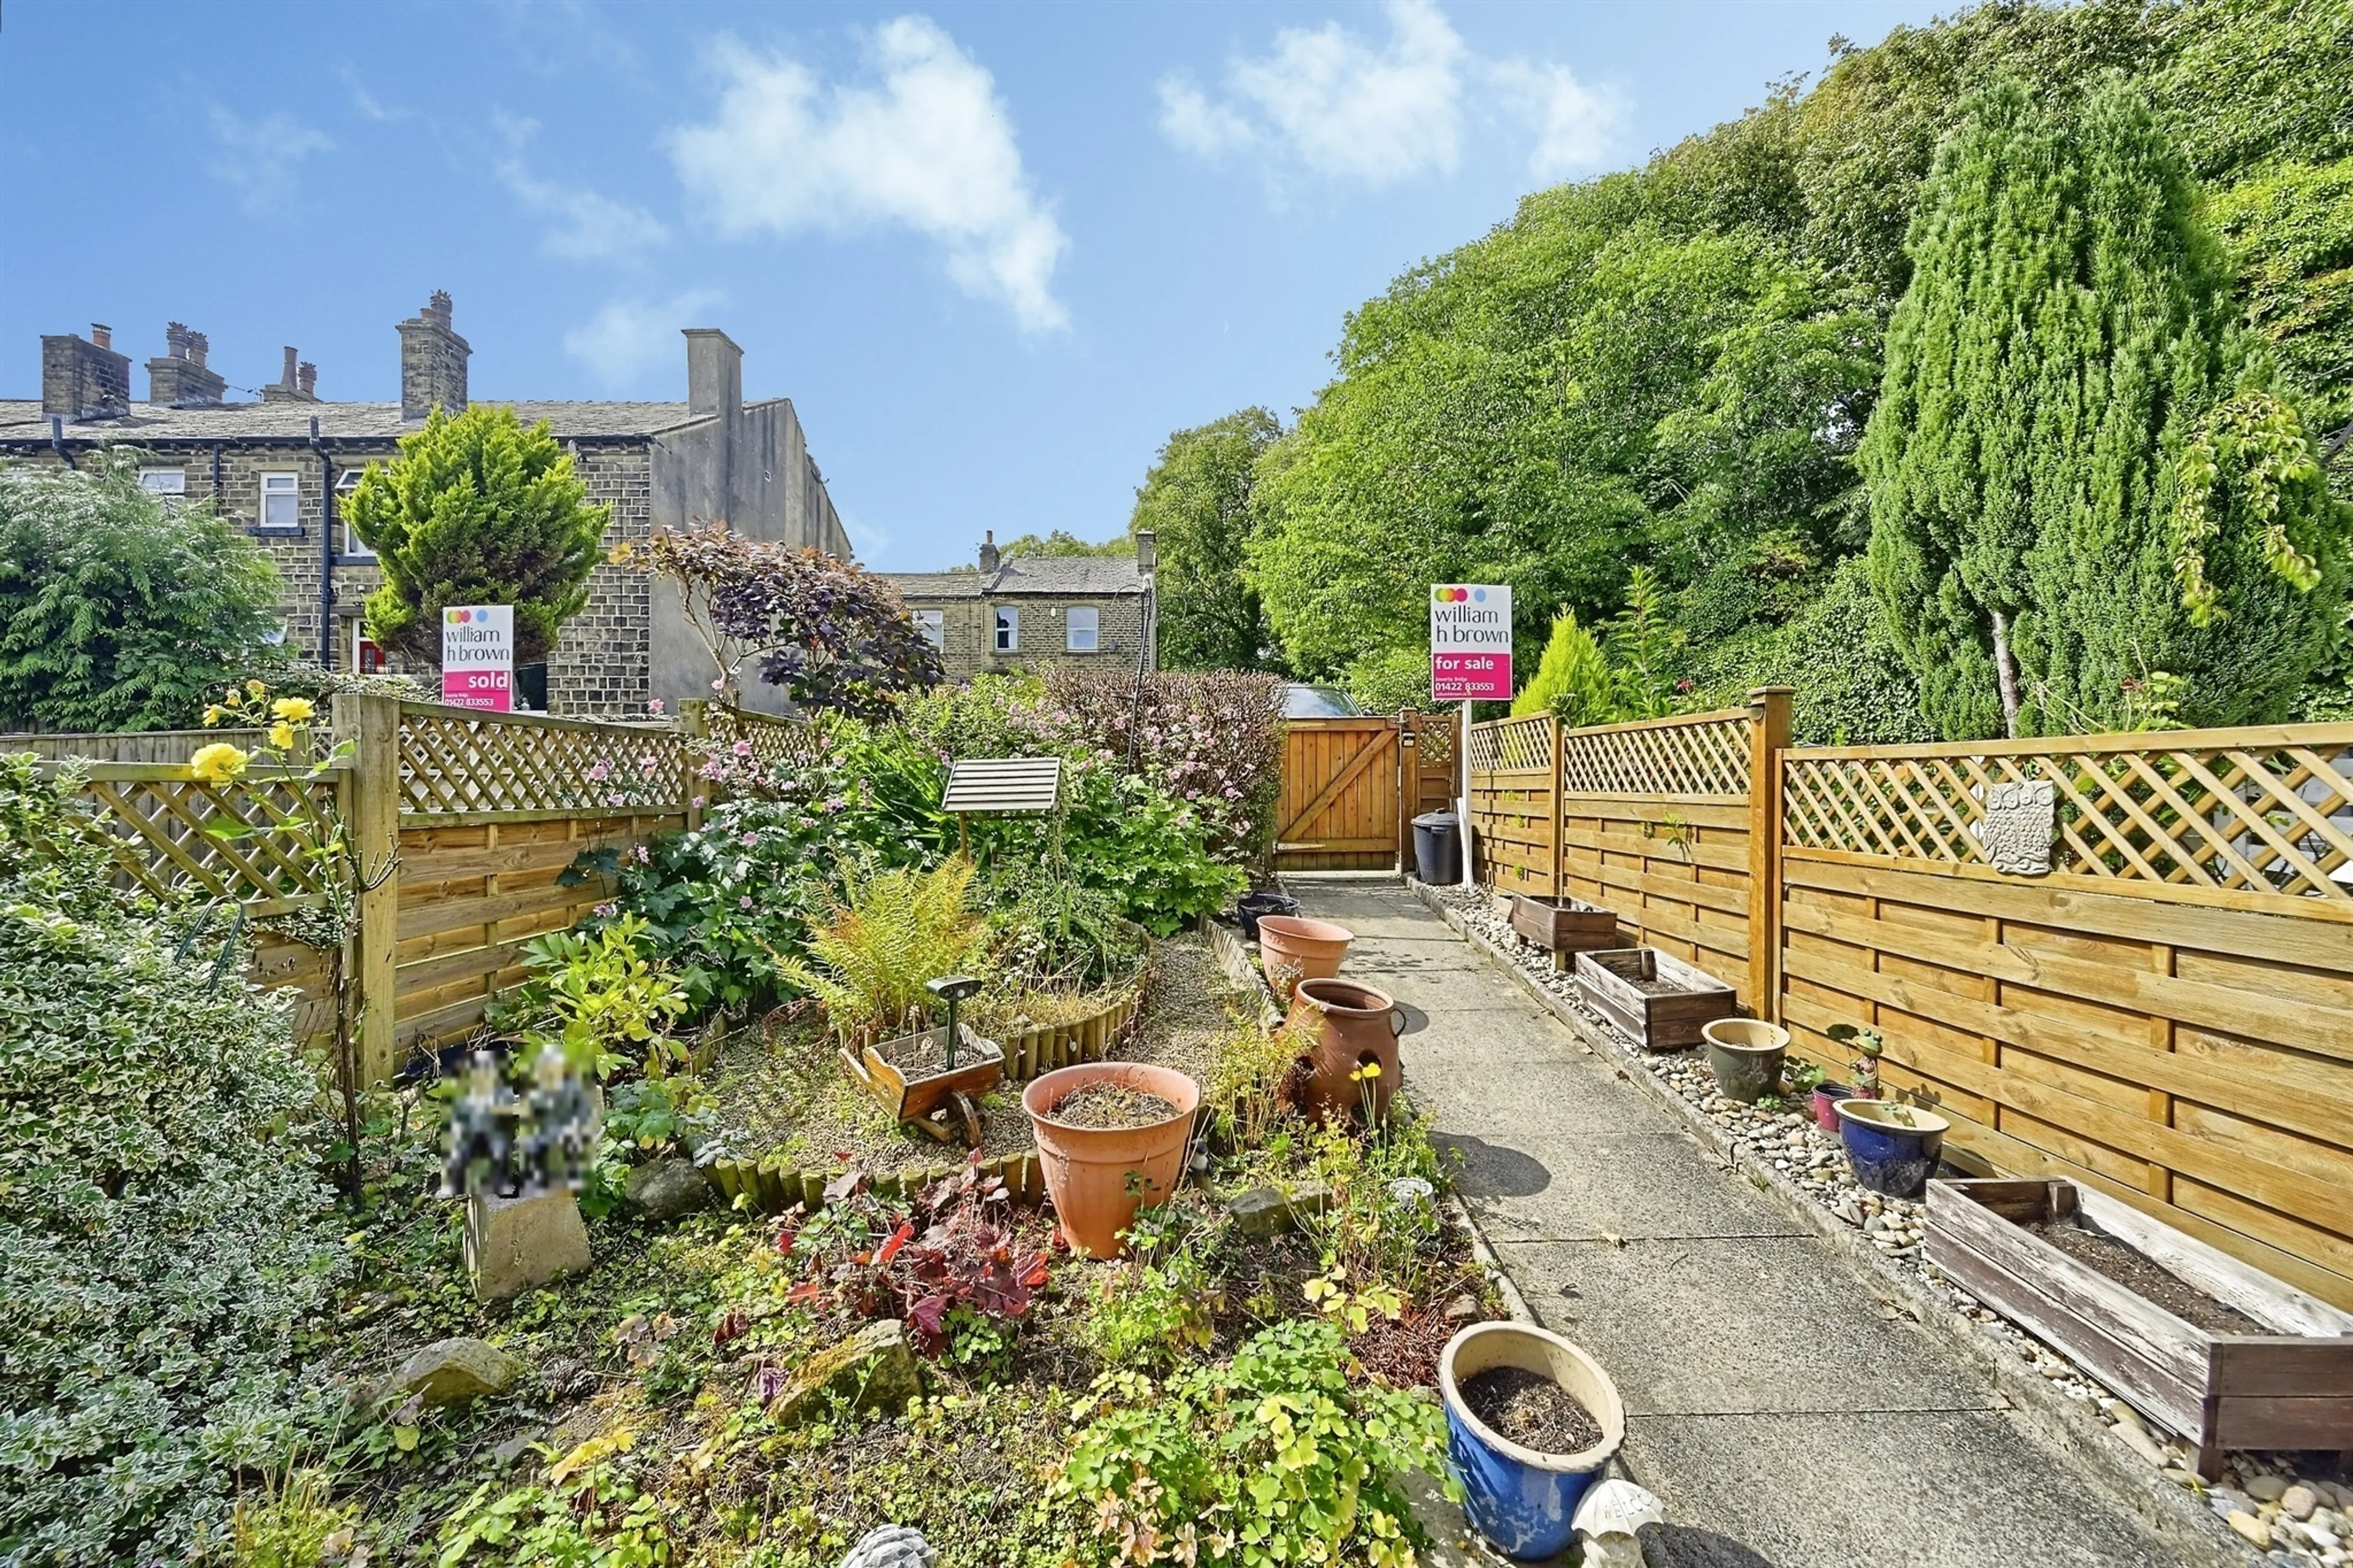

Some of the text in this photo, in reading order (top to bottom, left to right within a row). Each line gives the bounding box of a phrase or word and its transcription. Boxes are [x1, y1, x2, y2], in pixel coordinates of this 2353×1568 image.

[1435, 605, 1498, 623] william
[446, 626, 500, 642] william
[1437, 625, 1509, 643] h brown
[447, 645, 509, 661] h brown
[1435, 656, 1494, 670] for sale
[468, 672, 508, 688] sold
[1435, 682, 1495, 691] 01422 833553
